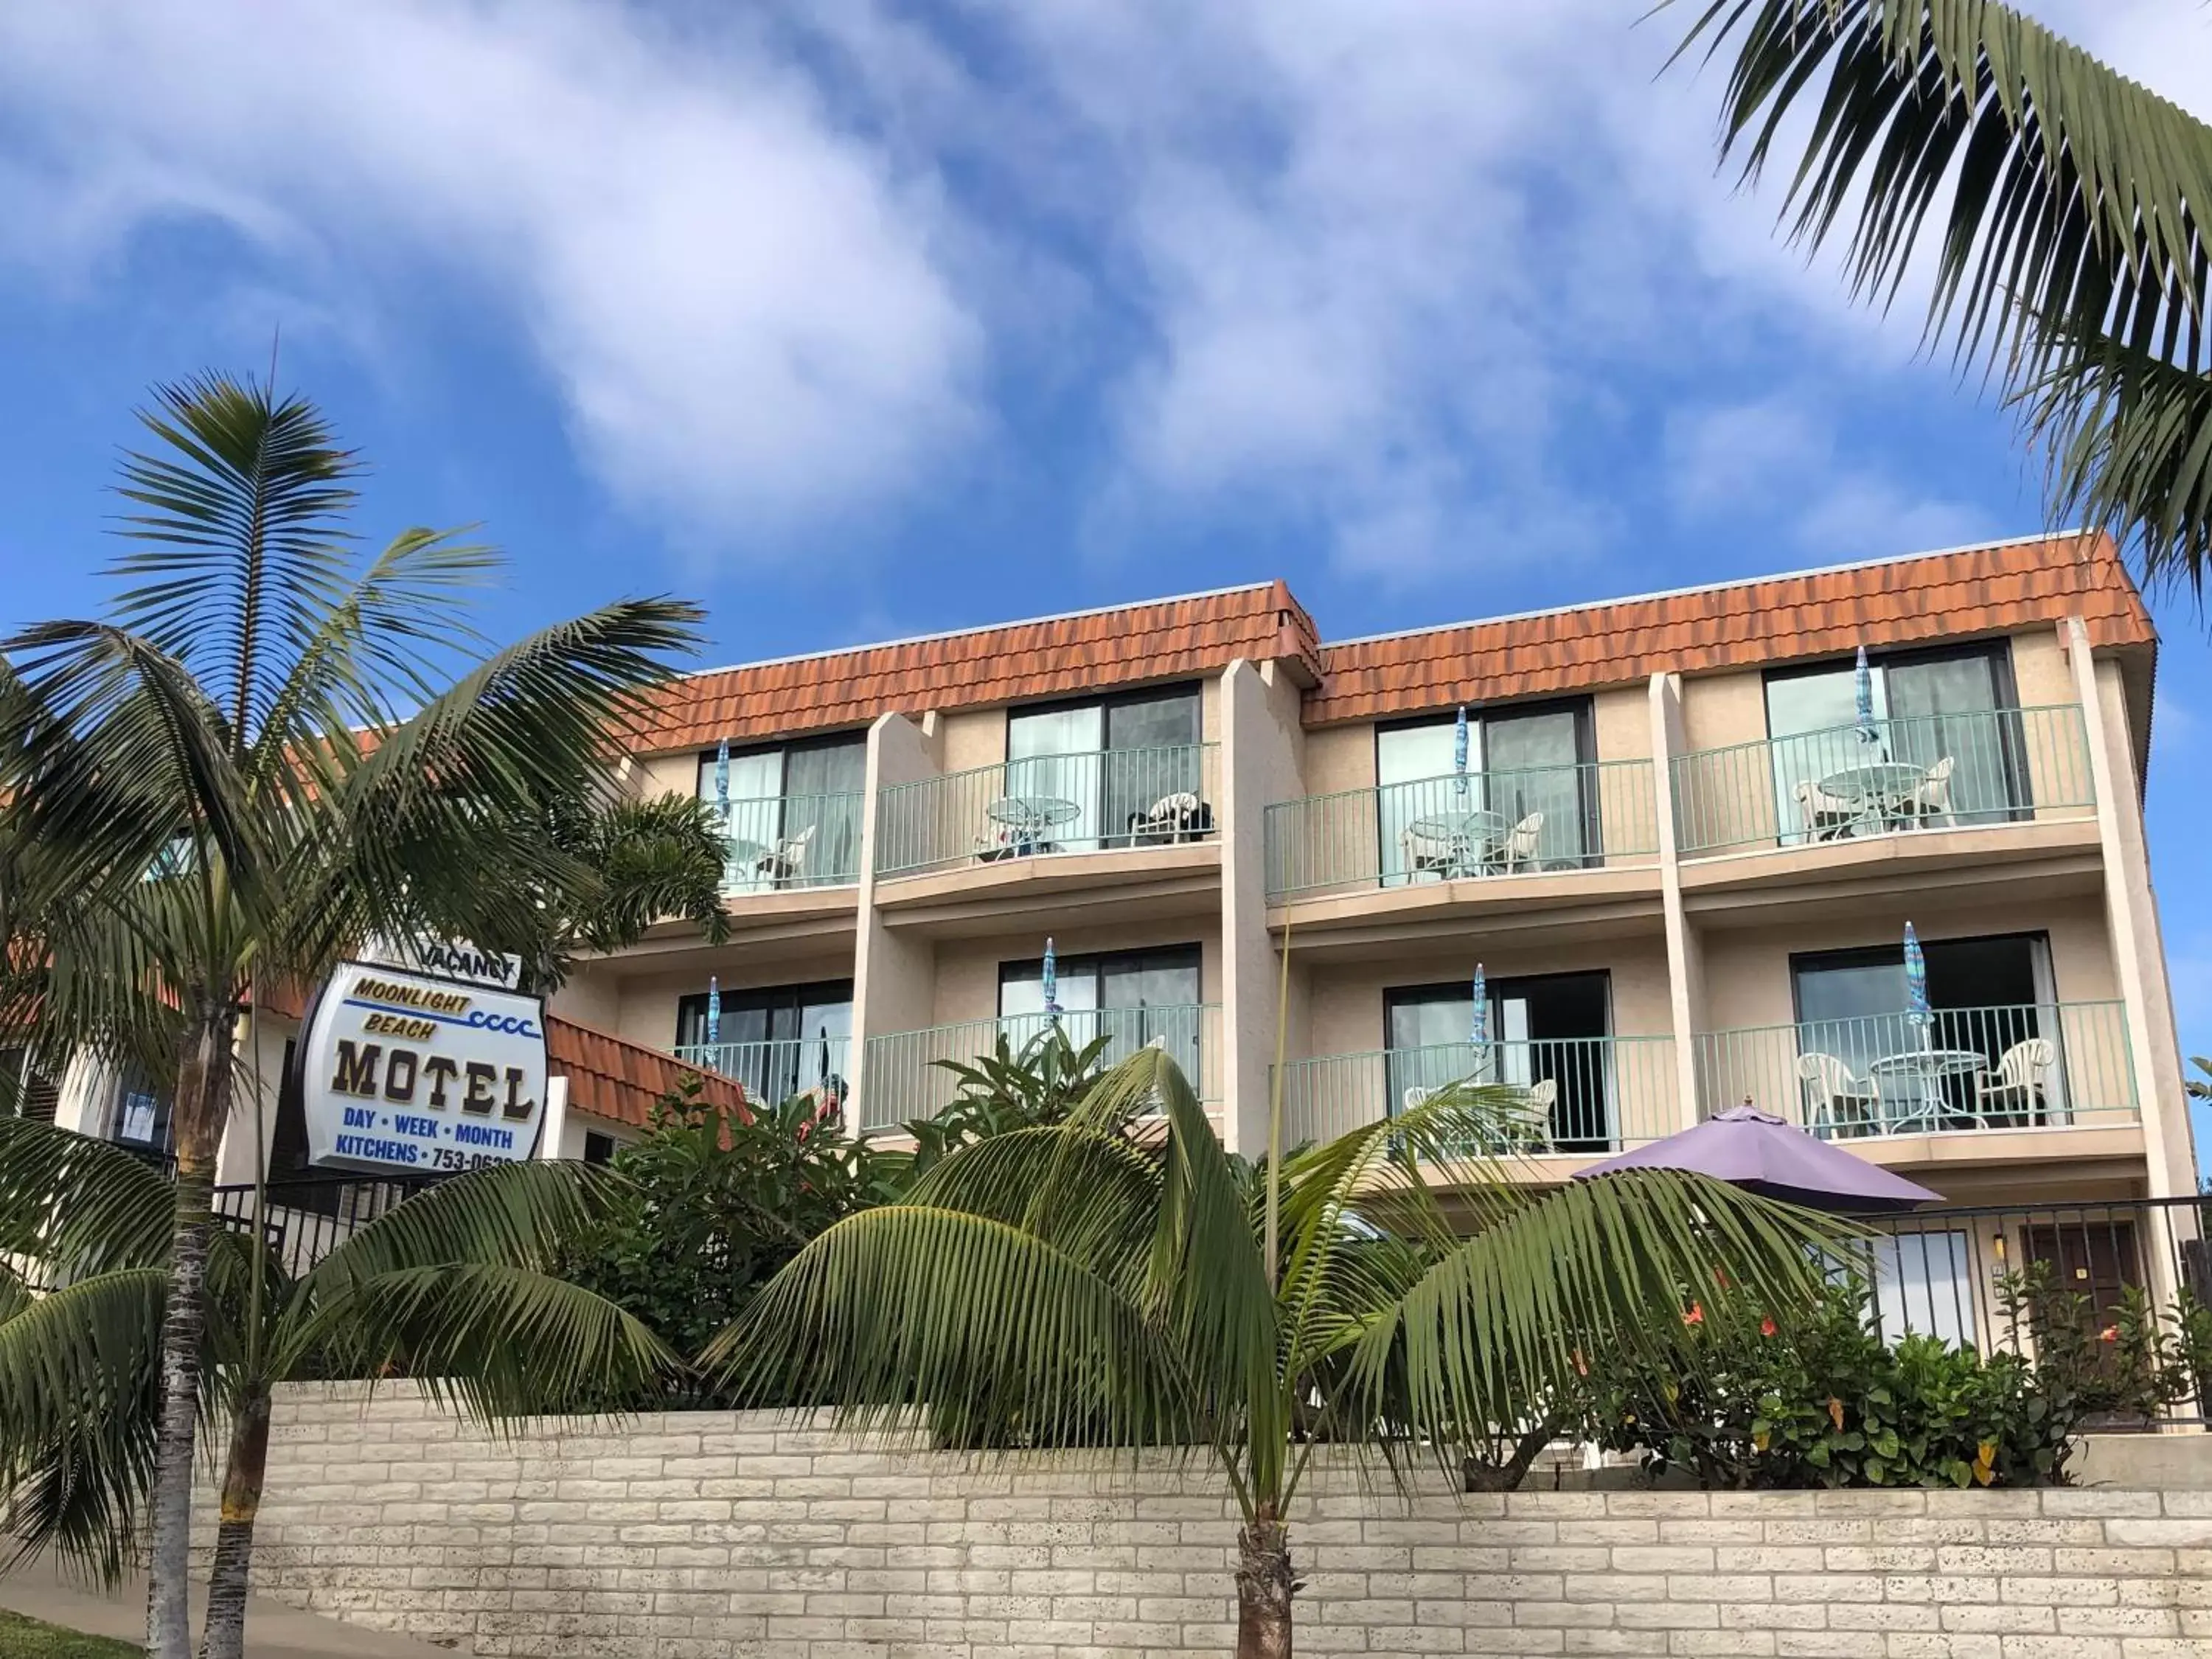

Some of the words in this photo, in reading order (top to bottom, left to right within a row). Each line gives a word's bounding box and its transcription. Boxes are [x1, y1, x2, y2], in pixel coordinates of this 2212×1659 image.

[354, 978, 470, 1014] MOONLIGHT
[364, 1013, 437, 1040] BEACH
[331, 1039, 535, 1120] MOTEL
[344, 1107, 377, 1129] DAY
[394, 1114, 439, 1138] WEEK
[455, 1124, 513, 1149] MONTH
[336, 1134, 418, 1163] KITCHENS
